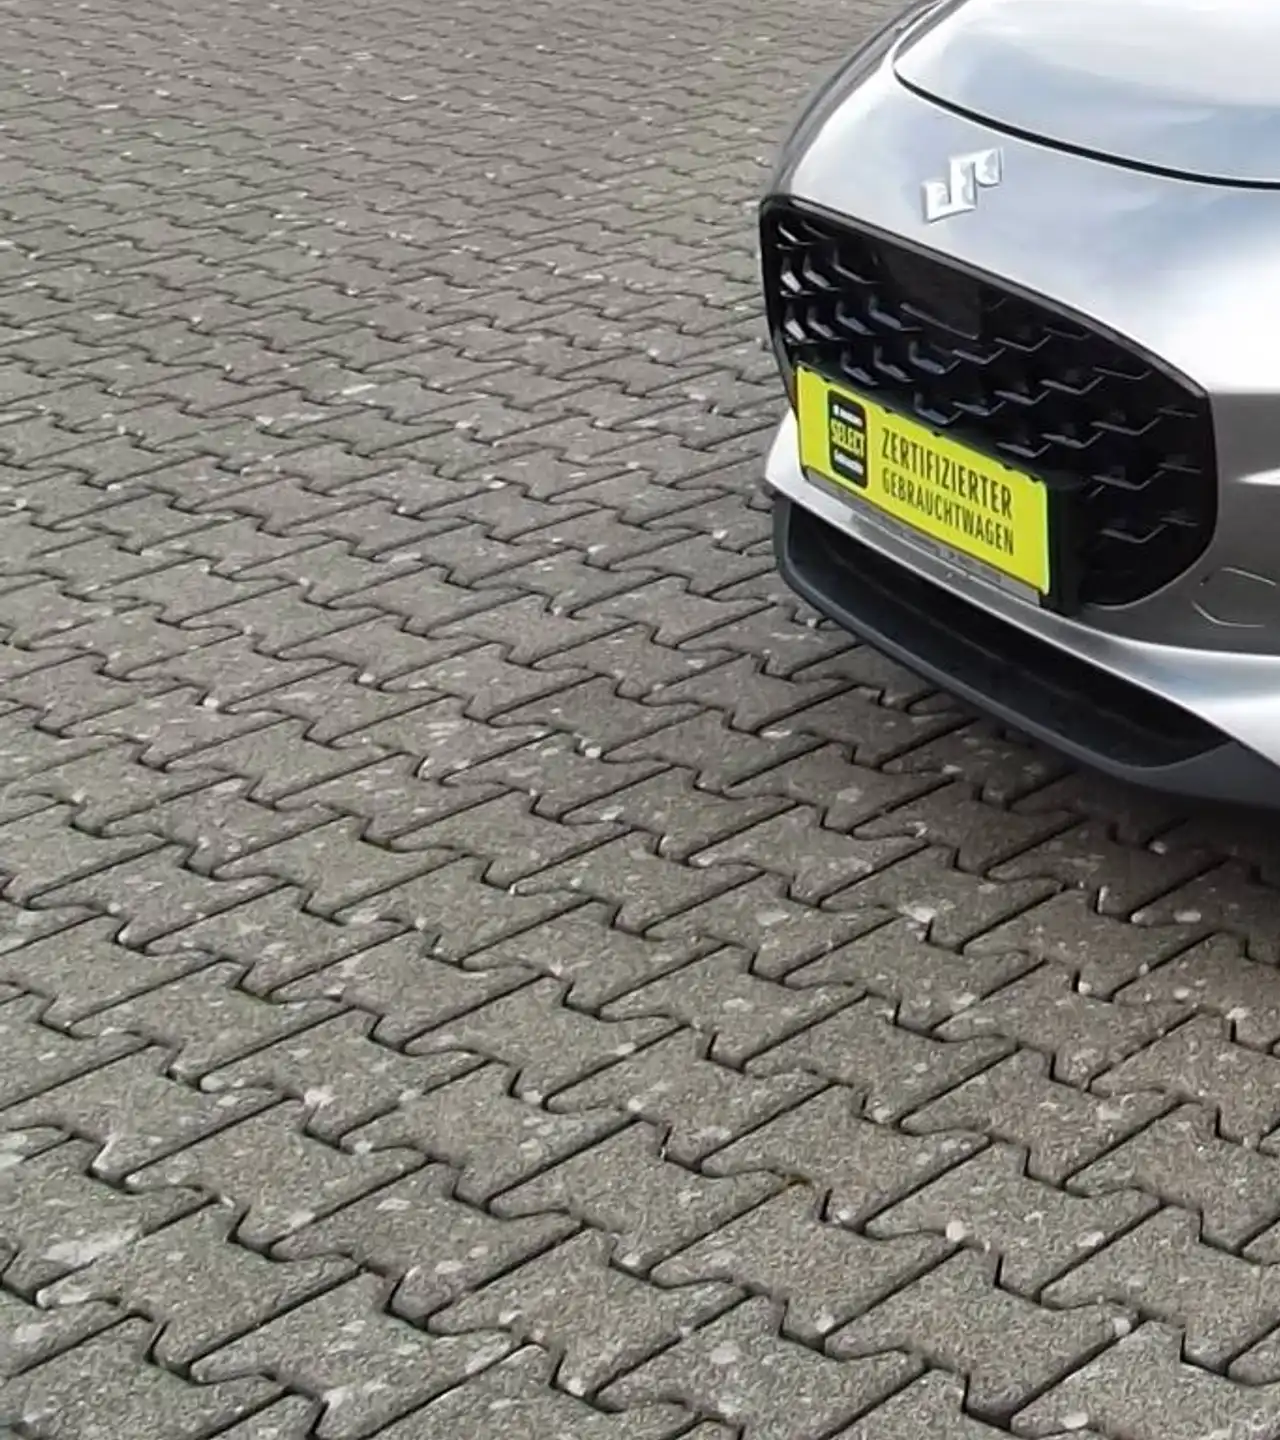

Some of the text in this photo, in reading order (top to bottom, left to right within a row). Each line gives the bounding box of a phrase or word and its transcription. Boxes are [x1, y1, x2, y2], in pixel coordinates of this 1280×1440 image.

[830, 417, 866, 459] SELECT
[880, 426, 1013, 521] ZERTIFIZIERTER
[881, 466, 1014, 557] GEBRAUCHTWAGEN
